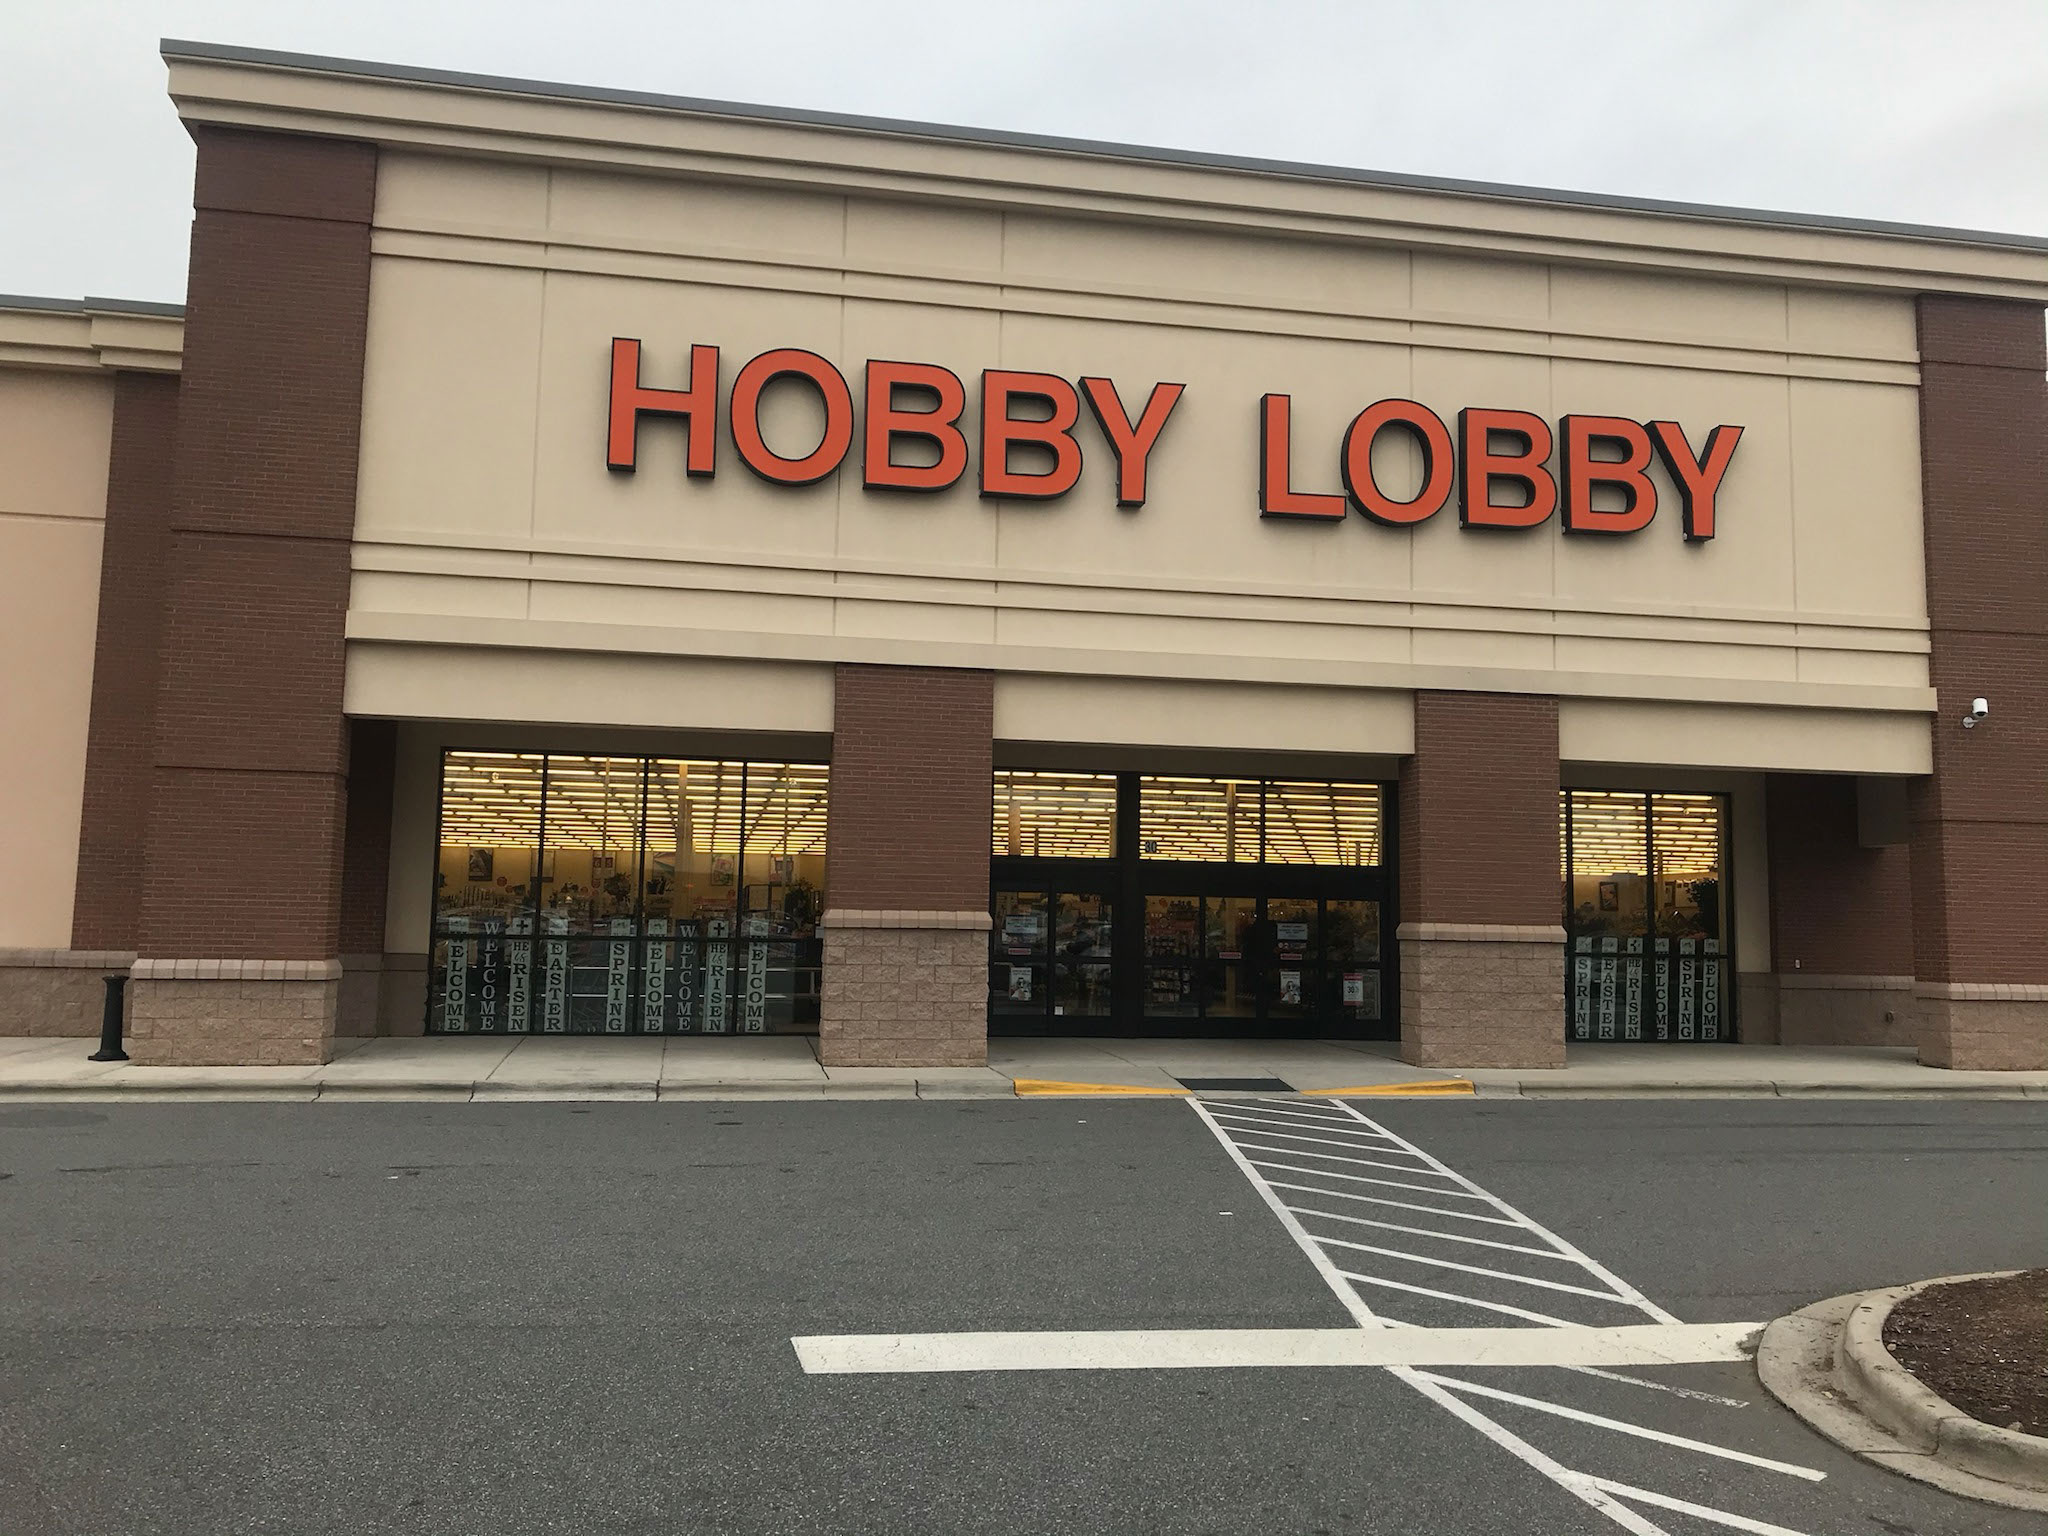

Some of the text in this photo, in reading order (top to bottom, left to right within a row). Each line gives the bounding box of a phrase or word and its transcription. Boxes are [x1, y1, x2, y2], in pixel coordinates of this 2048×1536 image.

[607, 337, 1745, 543] HOBBY LOBBY
[480, 922, 500, 1031] WELCOME
[513, 941, 529, 951] HE
[676, 925, 697, 1031] WELCOME
[710, 943, 726, 953] HE
[1628, 959, 1640, 967] HE
[510, 963, 527, 1030] RISEN
[546, 943, 563, 1030] EASTER
[608, 943, 625, 1030] SPRING
[709, 965, 725, 1030] RISEN
[1576, 958, 1588, 1037] SPRING
[1601, 958, 1614, 1037] EASTER
[1628, 978, 1640, 1038] RISEN
[1681, 960, 1692, 1037] SPRING
